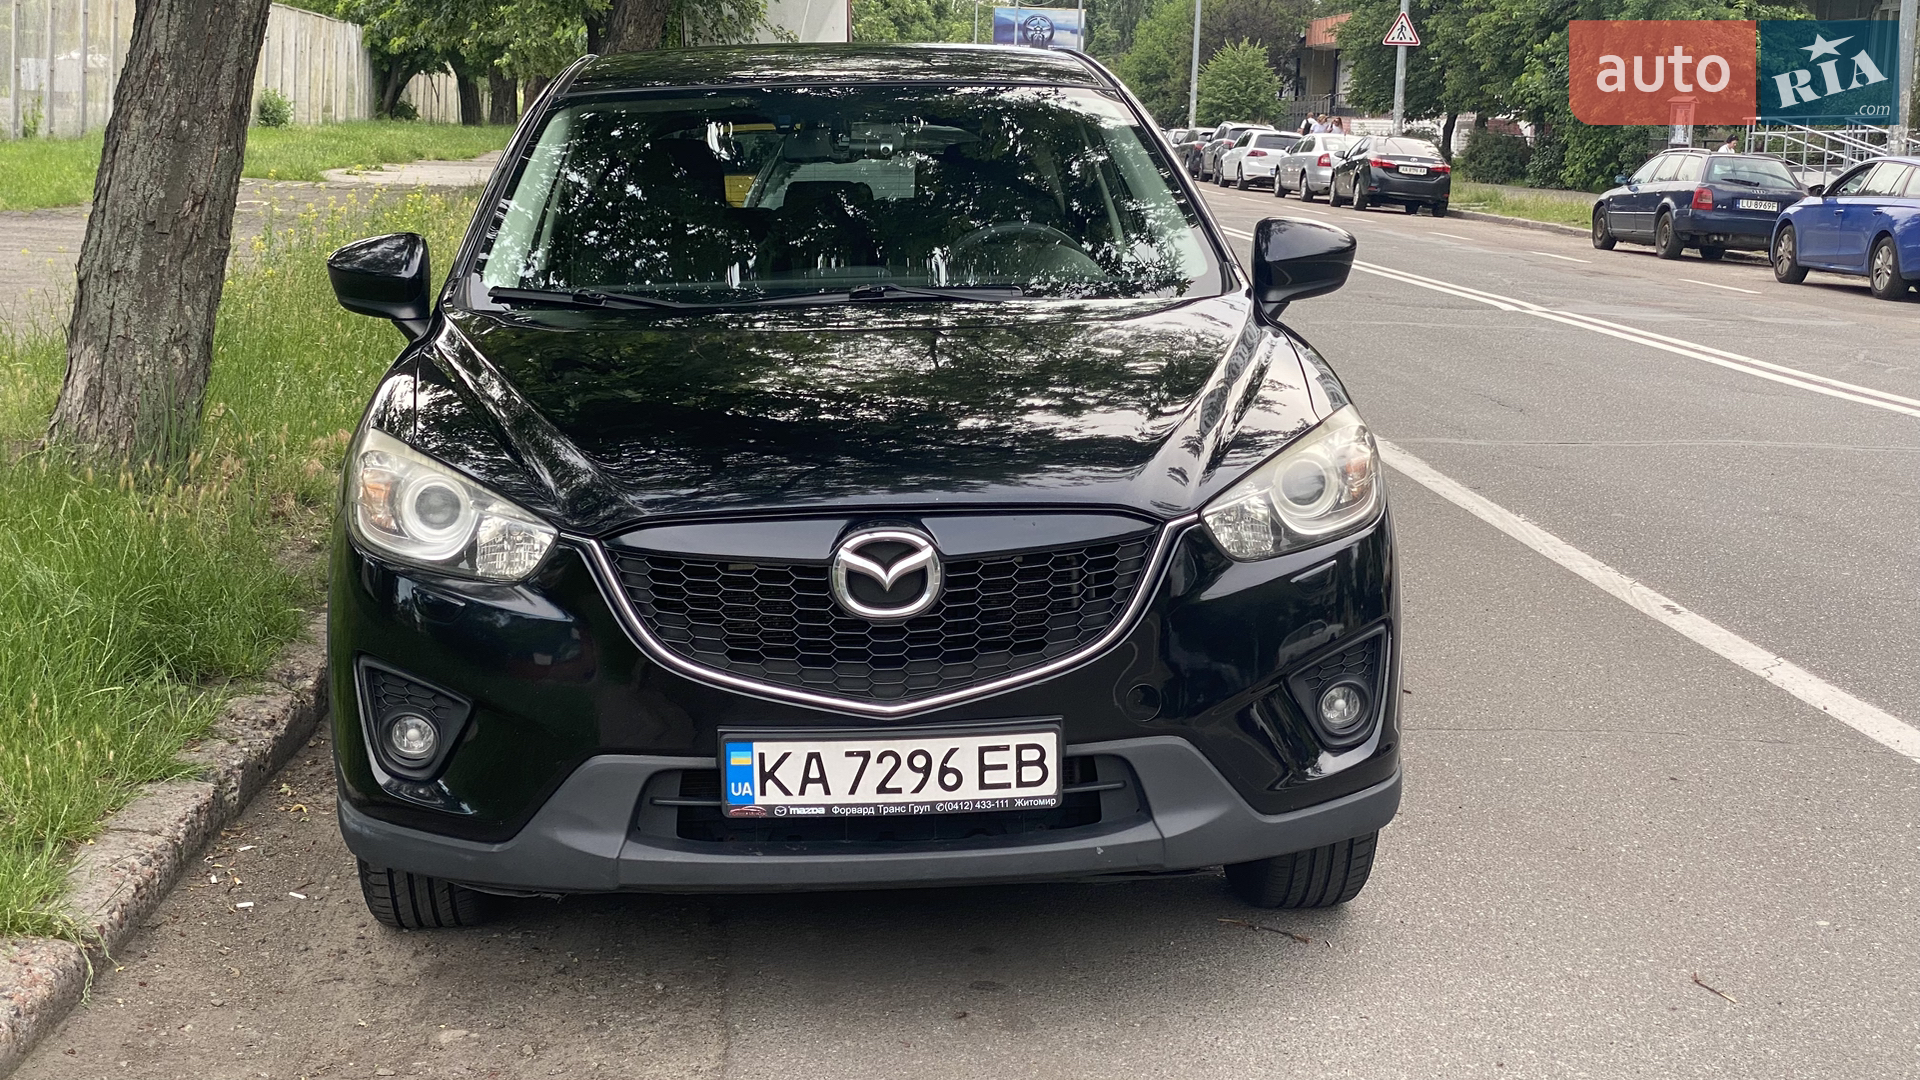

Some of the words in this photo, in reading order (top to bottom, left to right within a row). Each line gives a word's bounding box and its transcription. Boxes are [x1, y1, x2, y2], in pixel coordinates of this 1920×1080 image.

[1741, 200, 1752, 208] LU
[758, 751, 831, 797] KA
[844, 747, 964, 796] 7296
[978, 743, 1049, 791] EB
[731, 782, 753, 797] UA
[831, 805, 875, 816] Форвард
[877, 804, 906, 815] Транс
[908, 803, 931, 815] Груп
[975, 800, 1009, 810] 433-111
[1014, 798, 1057, 808] Житомир
